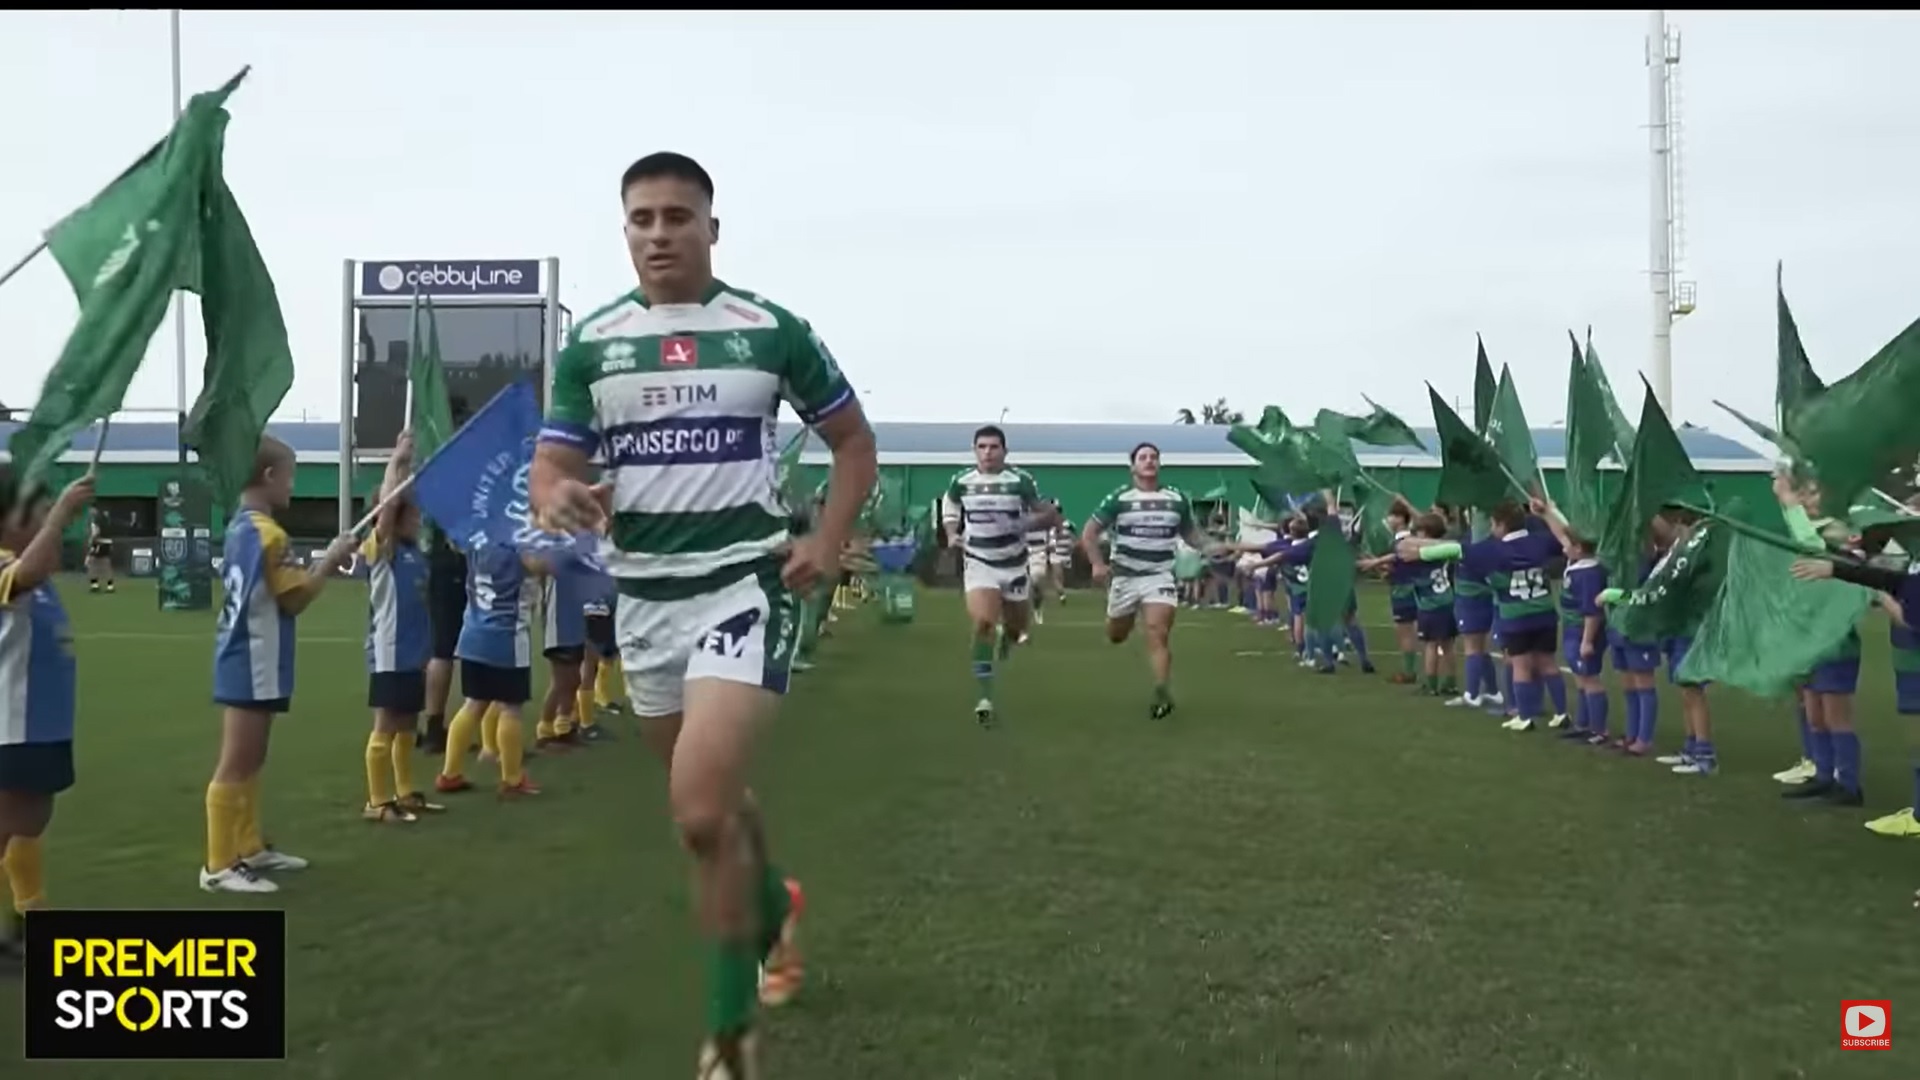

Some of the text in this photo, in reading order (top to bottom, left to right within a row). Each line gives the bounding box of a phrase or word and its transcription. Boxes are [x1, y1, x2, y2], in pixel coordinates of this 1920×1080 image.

[671, 384, 718, 404] TIM
[611, 428, 720, 457] PROSECCO
[1509, 567, 1548, 600] 42
